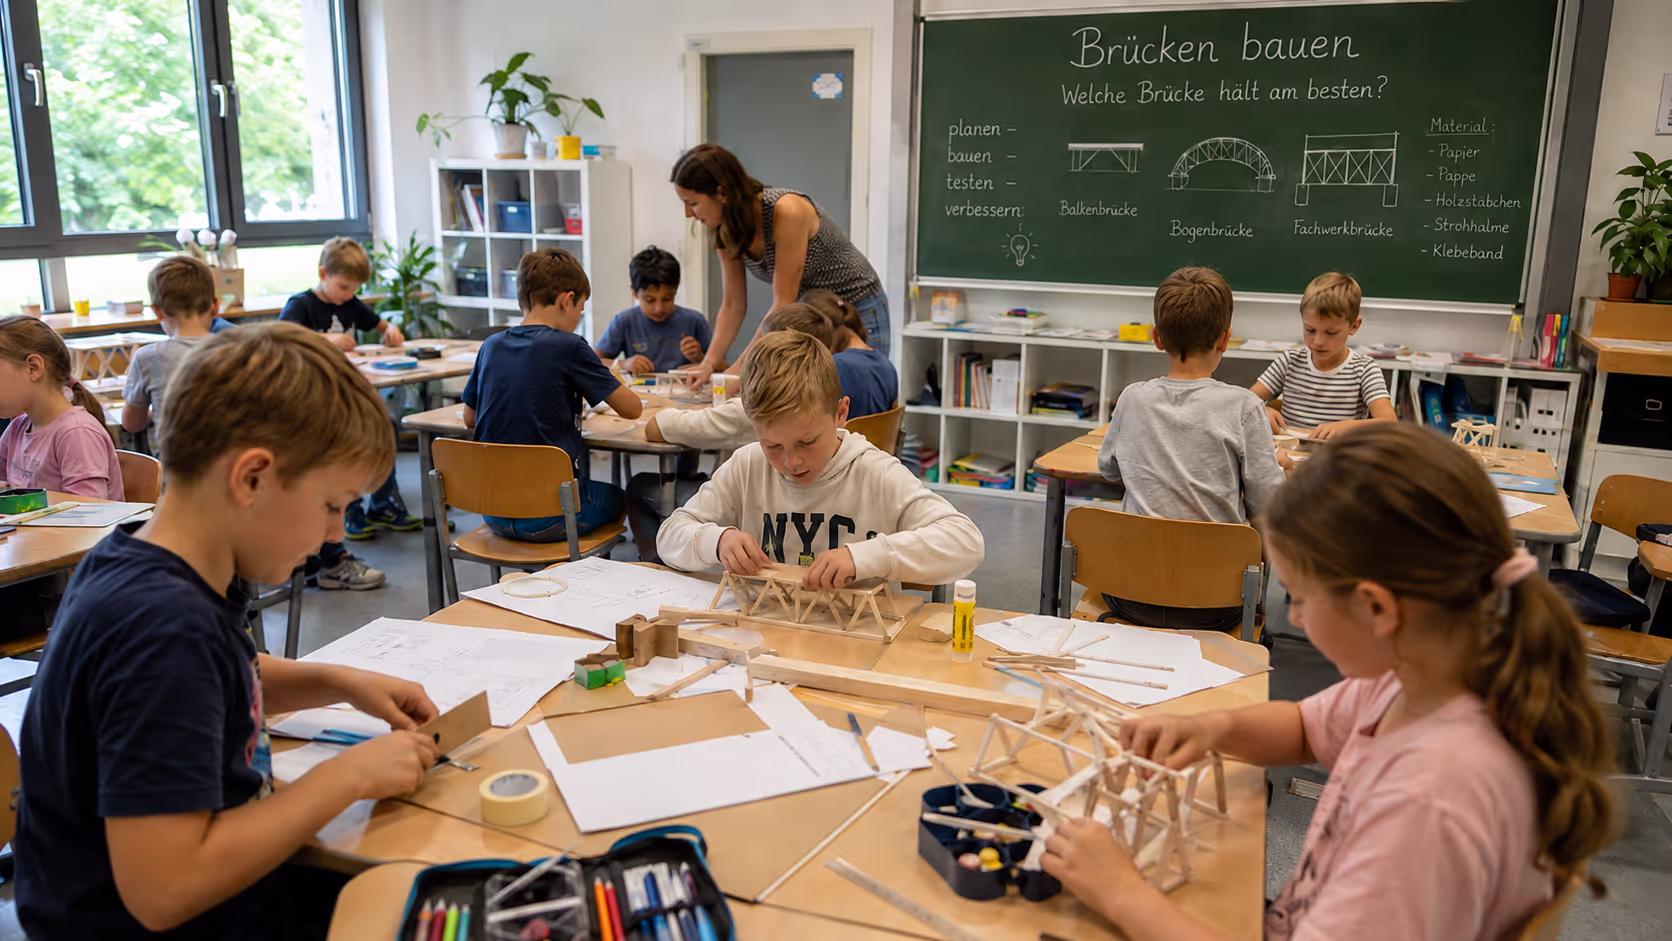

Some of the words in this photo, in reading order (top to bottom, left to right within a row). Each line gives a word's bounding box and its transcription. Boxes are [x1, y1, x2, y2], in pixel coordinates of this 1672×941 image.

[1070, 25, 1219, 68] Brücken
[1242, 21, 1359, 60] bauen
[1062, 83, 1126, 104] Welche
[1137, 80, 1204, 103] Brücke
[1220, 79, 1259, 100] hält
[1270, 88, 1298, 100] am
[1308, 75, 1388, 99] besten?
[949, 119, 1001, 144] planen
[948, 146, 992, 163] bauen
[1439, 143, 1480, 163] Papier
[946, 173, 994, 190] testen
[1439, 166, 1475, 187] Pappe
[1060, 200, 1138, 216] Balkenbrücke
[1437, 193, 1521, 208] Holzstäbchen
[1169, 220, 1253, 243] Bogenbrücke
[1294, 219, 1393, 236] Fachwerkbrücke
[1434, 217, 1509, 233] Strohhalme
[1433, 243, 1503, 259] Klebeband
